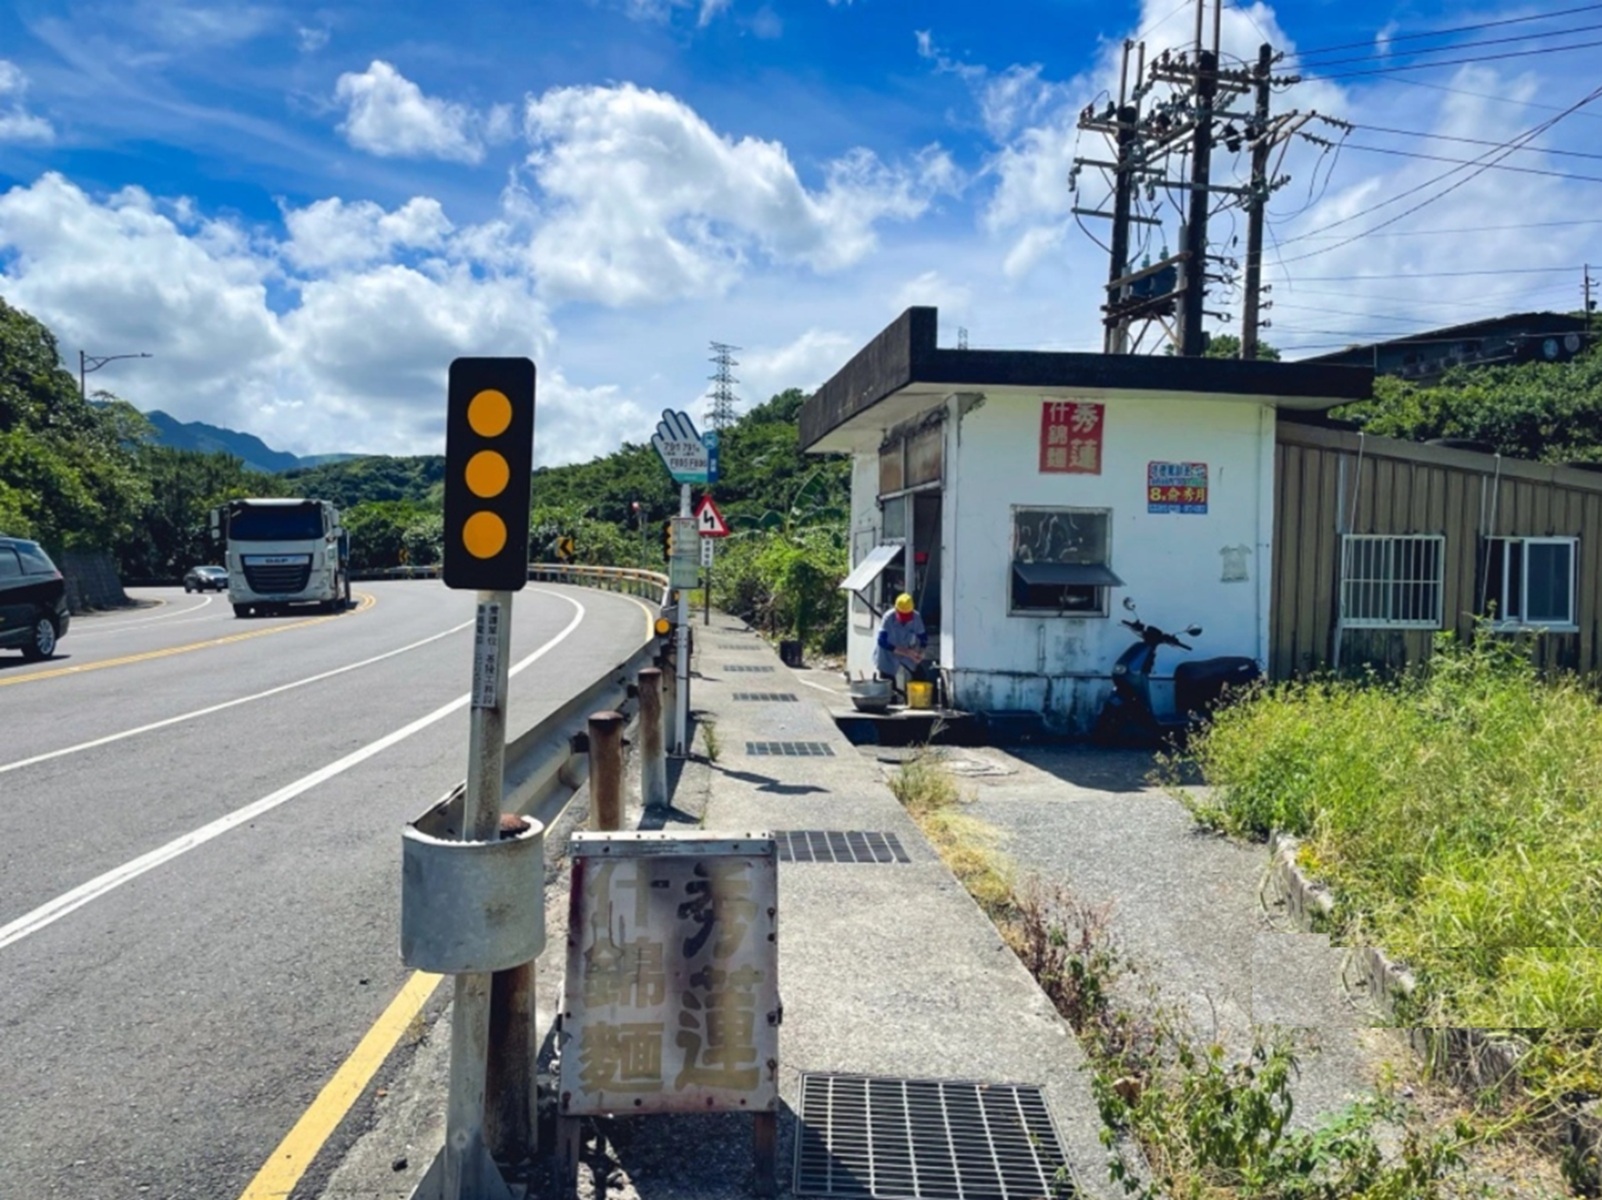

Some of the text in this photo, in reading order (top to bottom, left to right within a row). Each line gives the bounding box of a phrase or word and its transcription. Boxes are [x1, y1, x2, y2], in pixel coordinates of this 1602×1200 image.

[1070, 404, 1099, 469] 秀蓮
[579, 860, 666, 1095] 什錦麵
